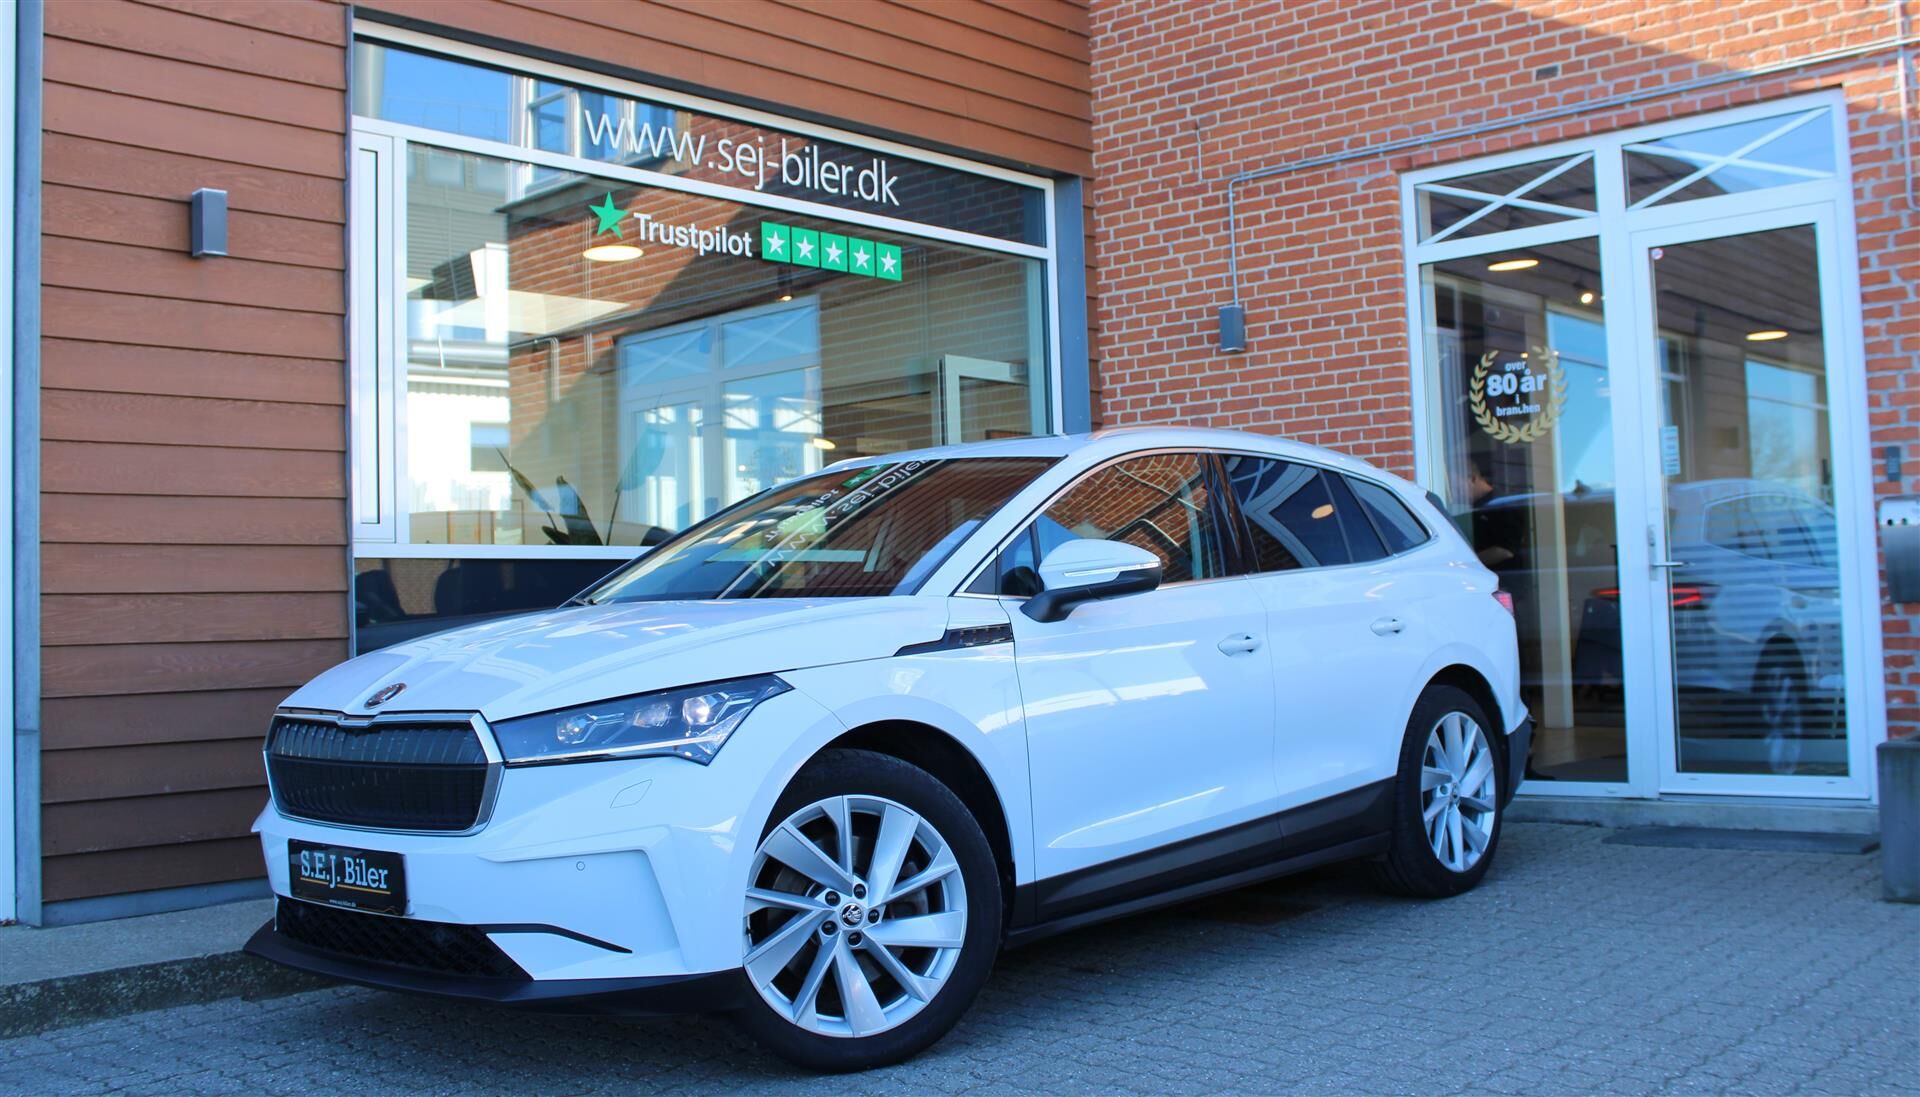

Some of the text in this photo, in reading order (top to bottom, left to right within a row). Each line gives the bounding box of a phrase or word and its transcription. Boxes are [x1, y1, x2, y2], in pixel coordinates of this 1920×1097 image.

[585, 109, 899, 206] www.sej-biler.dk
[633, 212, 753, 257] Trustpilot
[1504, 361, 1527, 372] over
[1487, 368, 1547, 396] 80 år
[1496, 404, 1541, 417] branchen
[1515, 394, 1520, 404] i
[300, 849, 389, 889] S.E.J. Biler
